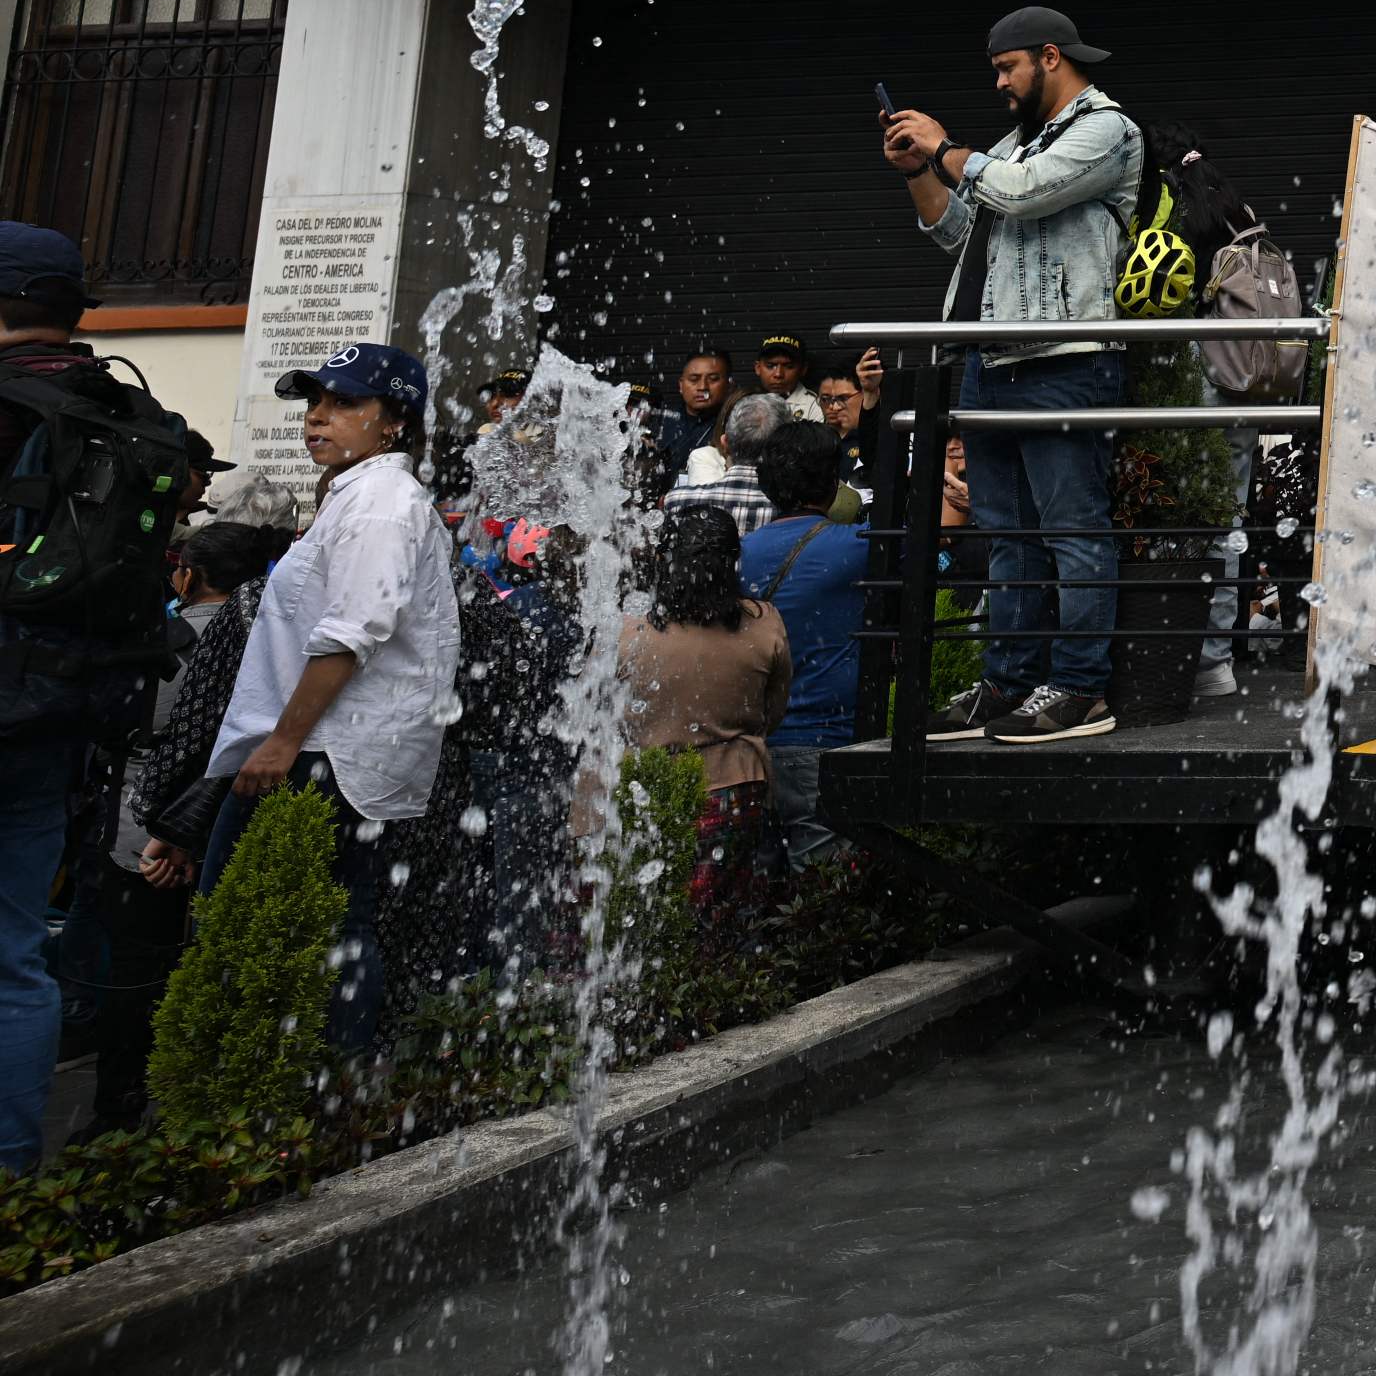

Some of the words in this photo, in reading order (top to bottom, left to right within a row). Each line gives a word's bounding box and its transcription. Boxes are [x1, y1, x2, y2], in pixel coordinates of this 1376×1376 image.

[276, 219, 297, 231] CASA
[299, 218, 312, 230] DEL
[325, 217, 352, 229] PEDRO
[353, 216, 383, 228] MOLINA
[279, 235, 304, 245] INSIGNE
[305, 234, 343, 245] PRECURSOR
[349, 233, 375, 243] PROCER
[284, 249, 293, 259] DE
[295, 249, 303, 259] LA
[304, 248, 356, 258] INDEPENDENCIA
[357, 247, 367, 257] DE
[283, 264, 318, 279] CENTRO
[324, 264, 364, 278] AMERICA
[264, 285, 289, 295] PALADIN
[290, 285, 299, 295] DE
[300, 285, 312, 295] LOS
[313, 284, 339, 294] IDEALES
[340, 284, 348, 293] DE
[349, 283, 379, 293] LIBERTAD
[303, 298, 341, 308] DEMOCRACIA
[262, 312, 316, 323] REPRESENTANTE
[317, 311, 327, 322] EN
[327, 311, 335, 321] EL
[337, 310, 373, 321] CONGRESO
[306, 327, 315, 337] DE
[316, 326, 343, 337] PANAMA
[345, 326, 354, 336] EN
[355, 325, 370, 336] 1826
[271, 343, 279, 355] 17
[280, 343, 289, 355] DE
[290, 342, 328, 355] DICIEMBRE
[330, 341, 340, 354] DE
[762, 336, 799, 348] POLICIA
[271, 427, 299, 440] DOLORES
